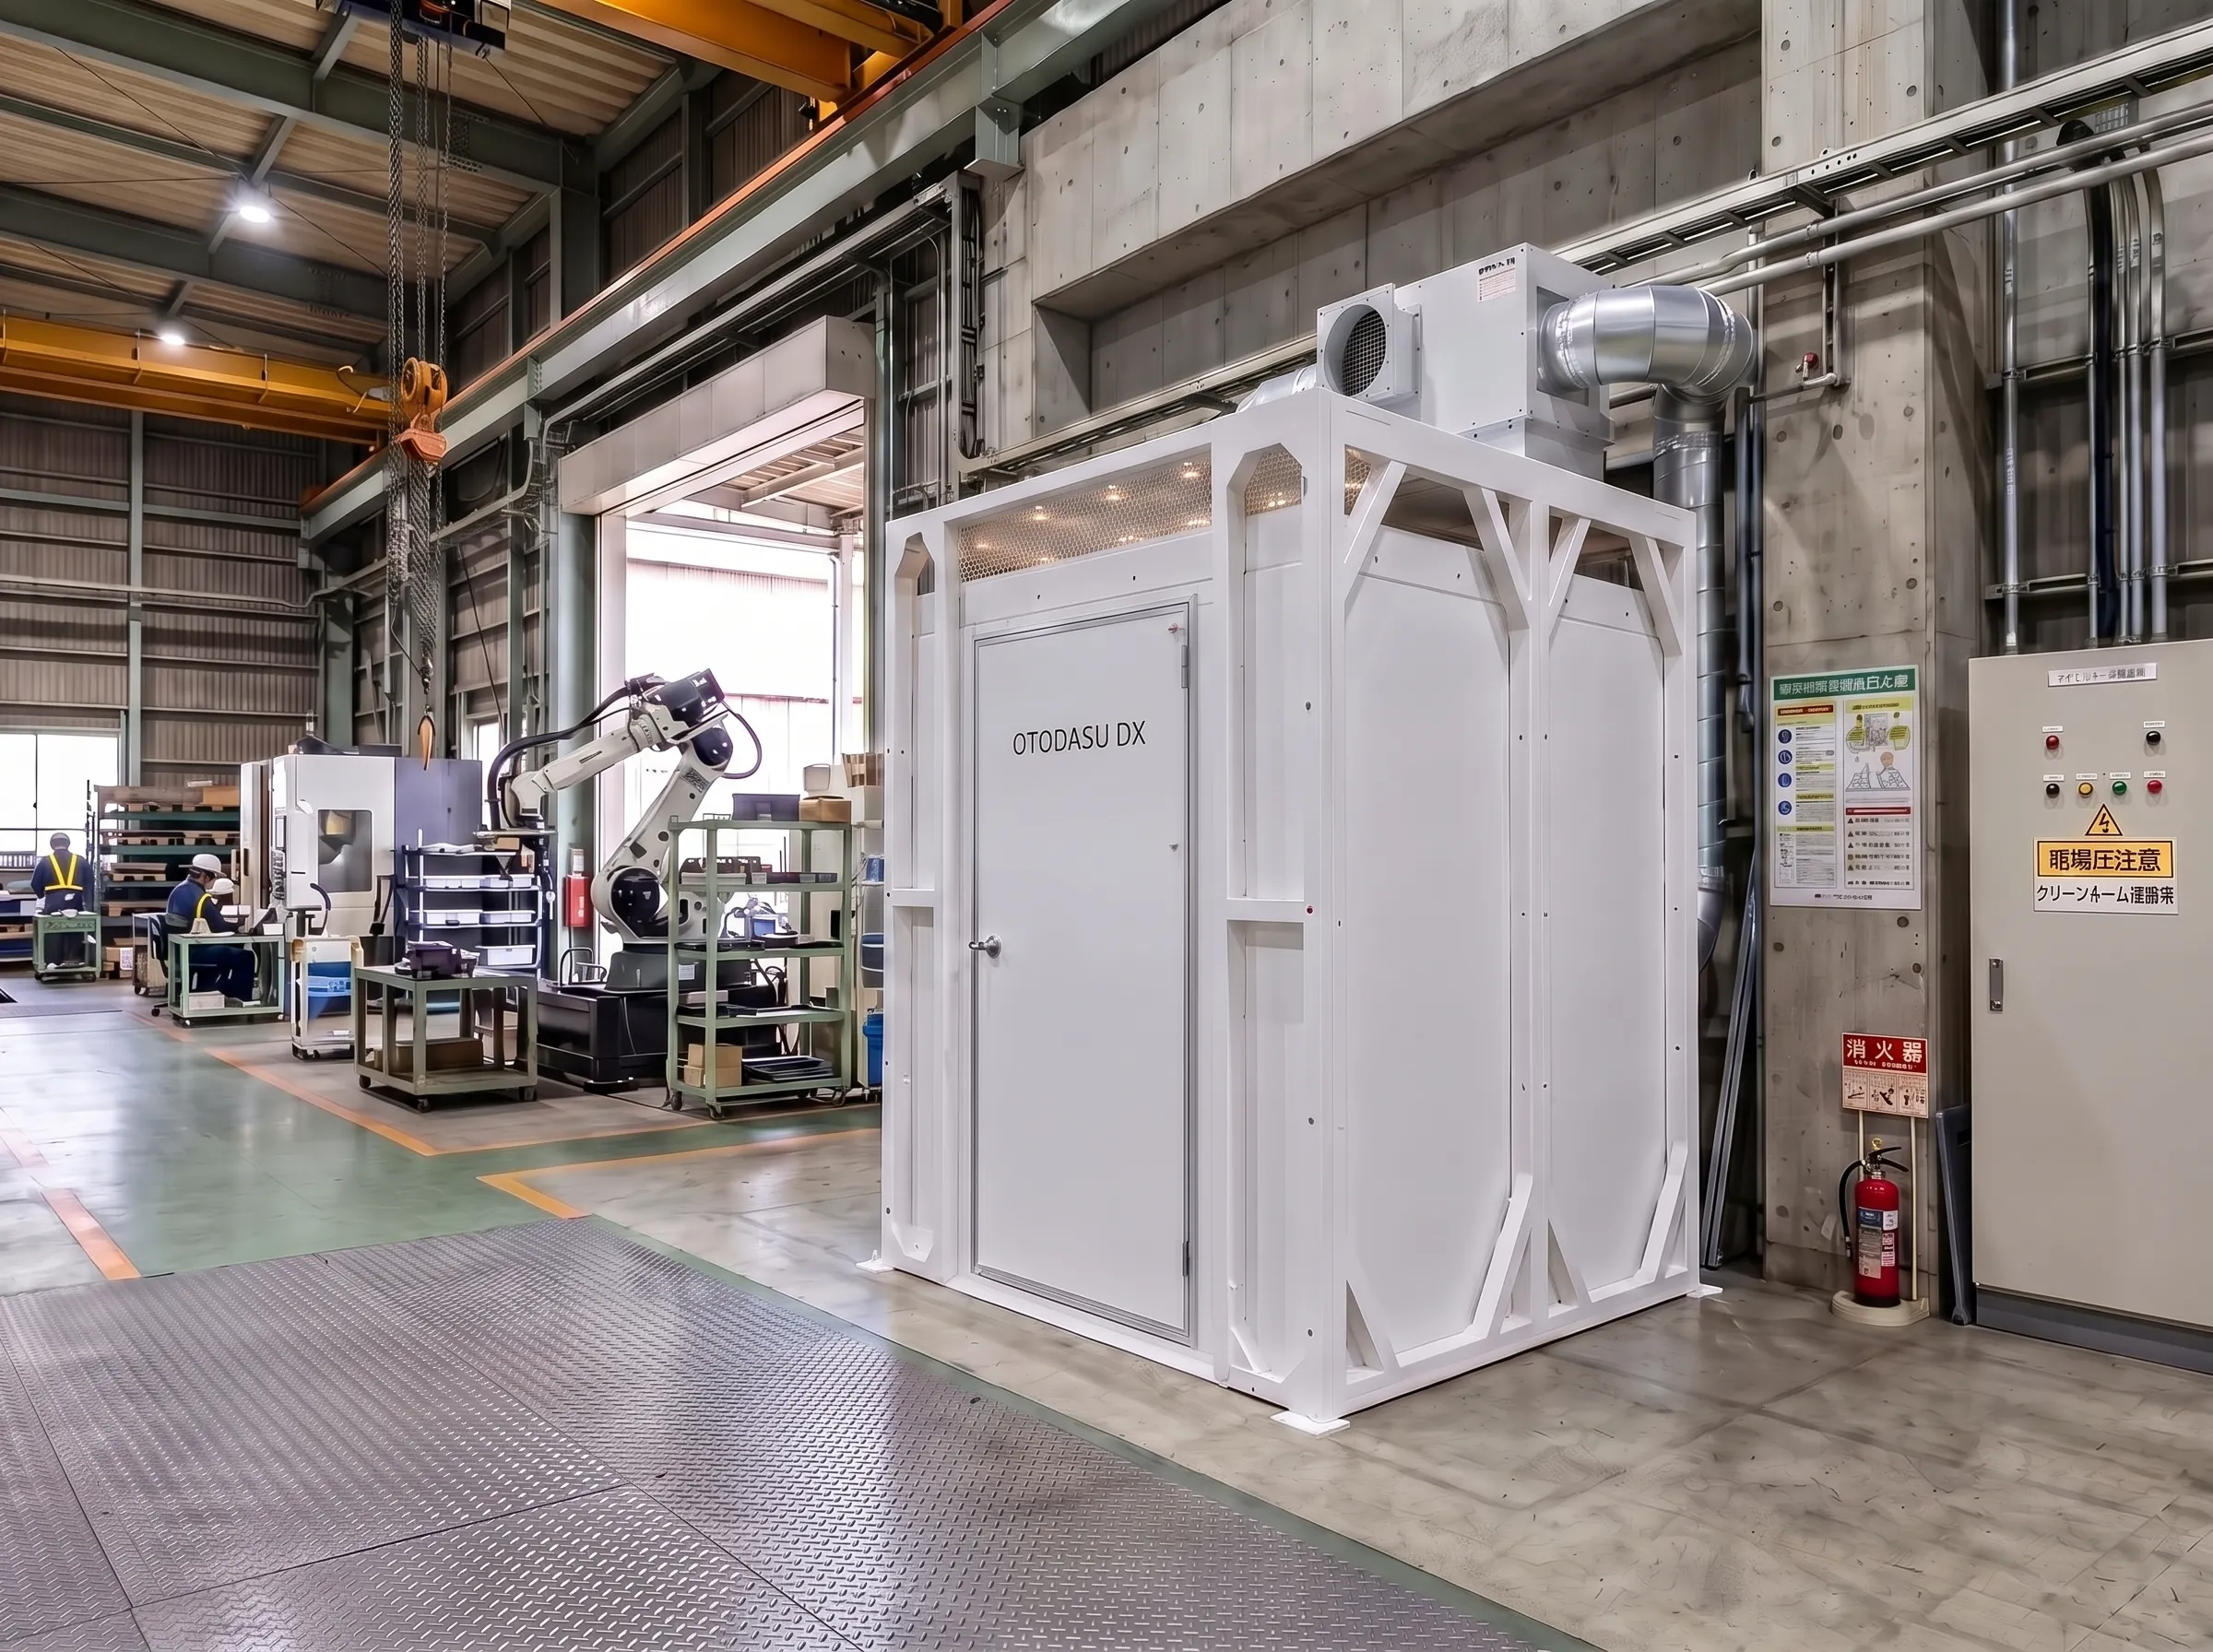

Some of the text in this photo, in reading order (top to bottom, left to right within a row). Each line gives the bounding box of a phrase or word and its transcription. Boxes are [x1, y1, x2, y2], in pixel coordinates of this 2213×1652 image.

[1012, 720, 1146, 755] OTODASU DX
[1846, 1038, 1923, 1063] 消火器
